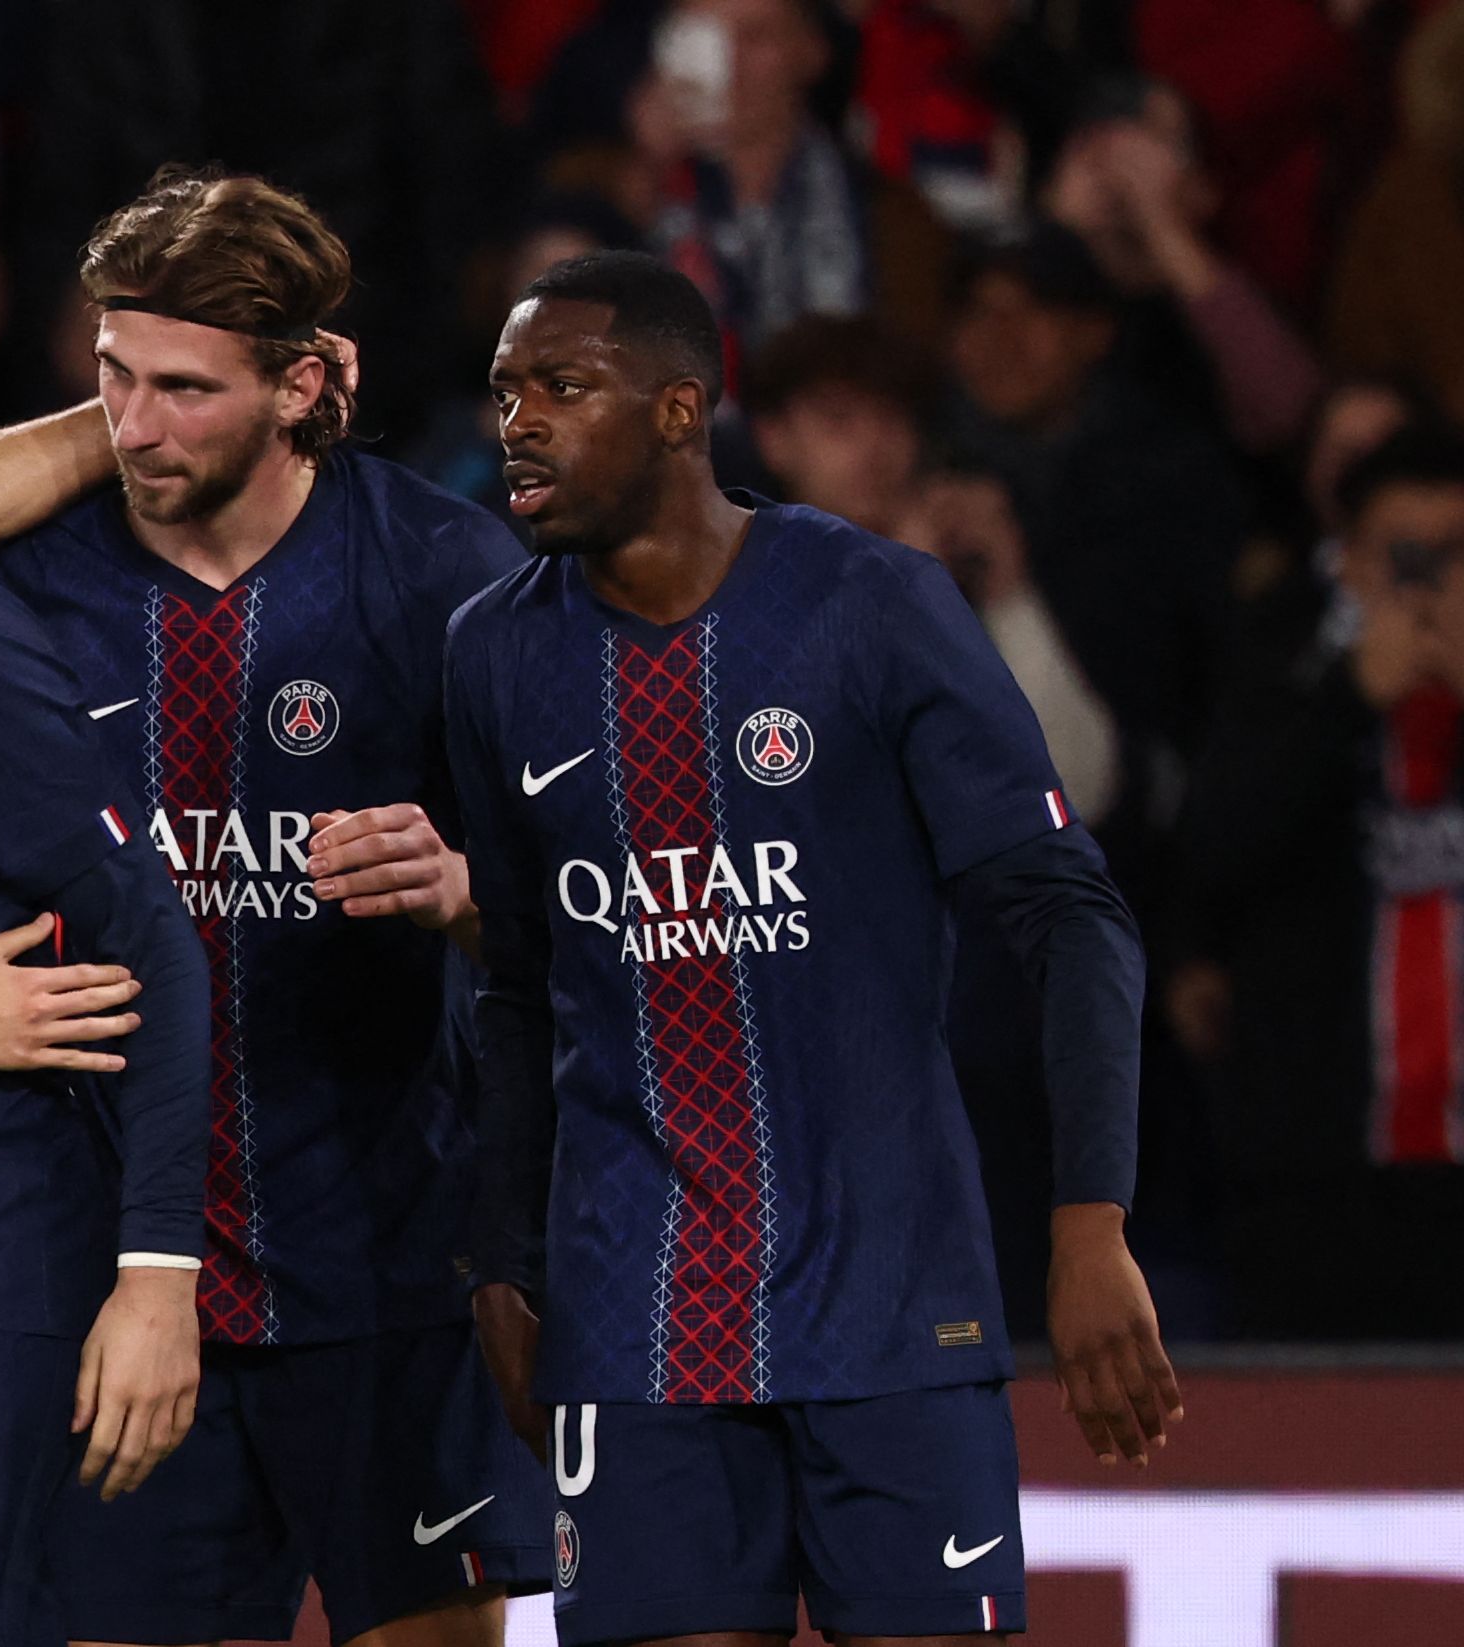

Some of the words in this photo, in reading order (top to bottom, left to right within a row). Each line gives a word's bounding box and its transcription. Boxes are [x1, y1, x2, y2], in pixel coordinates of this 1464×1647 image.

[282, 683, 328, 703] PARIS
[748, 711, 799, 733] PARIS
[148, 808, 311, 873] ATAR
[173, 880, 318, 921] RWAYS
[558, 839, 808, 935] QATAR
[620, 910, 811, 964] AIRWAYS
